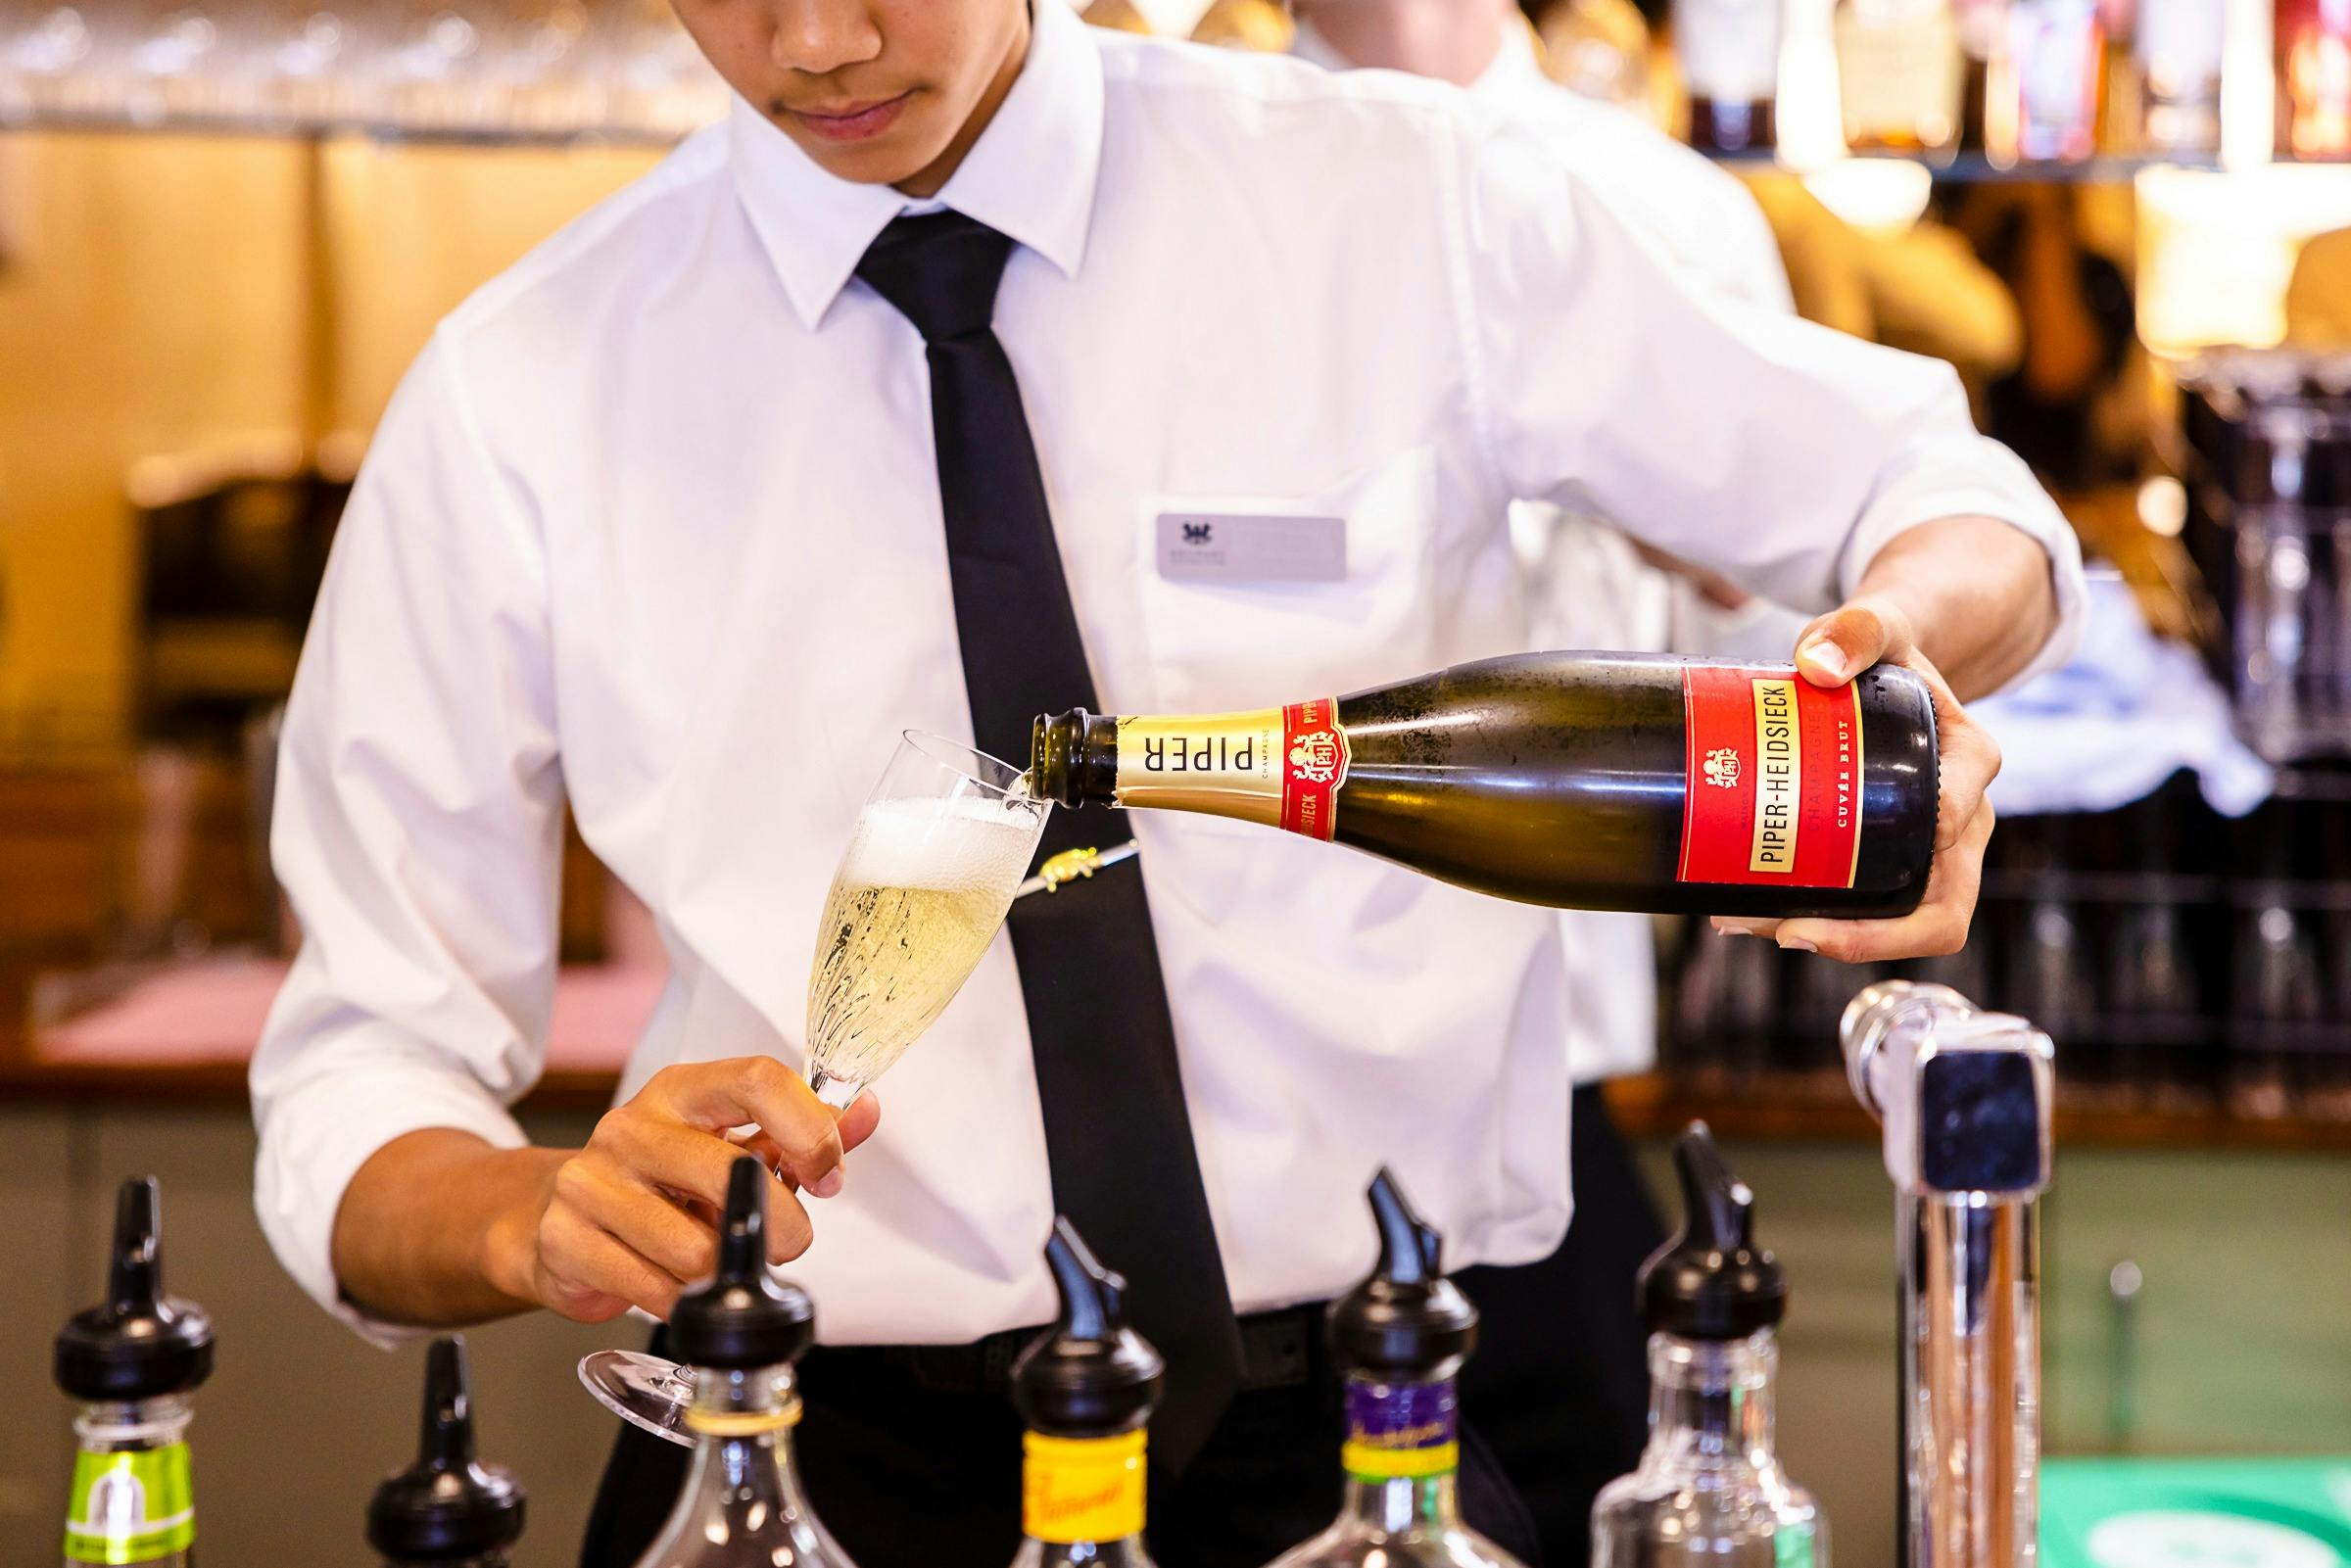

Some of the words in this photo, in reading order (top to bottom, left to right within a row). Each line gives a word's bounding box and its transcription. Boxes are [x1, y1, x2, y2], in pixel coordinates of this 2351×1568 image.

[1144, 736, 1253, 772] PIPER
[1839, 721, 1849, 763] BRUT
[1760, 687, 1790, 863] PIPER-HEIDSIECK
[1838, 772, 1849, 828] CUVÉE
